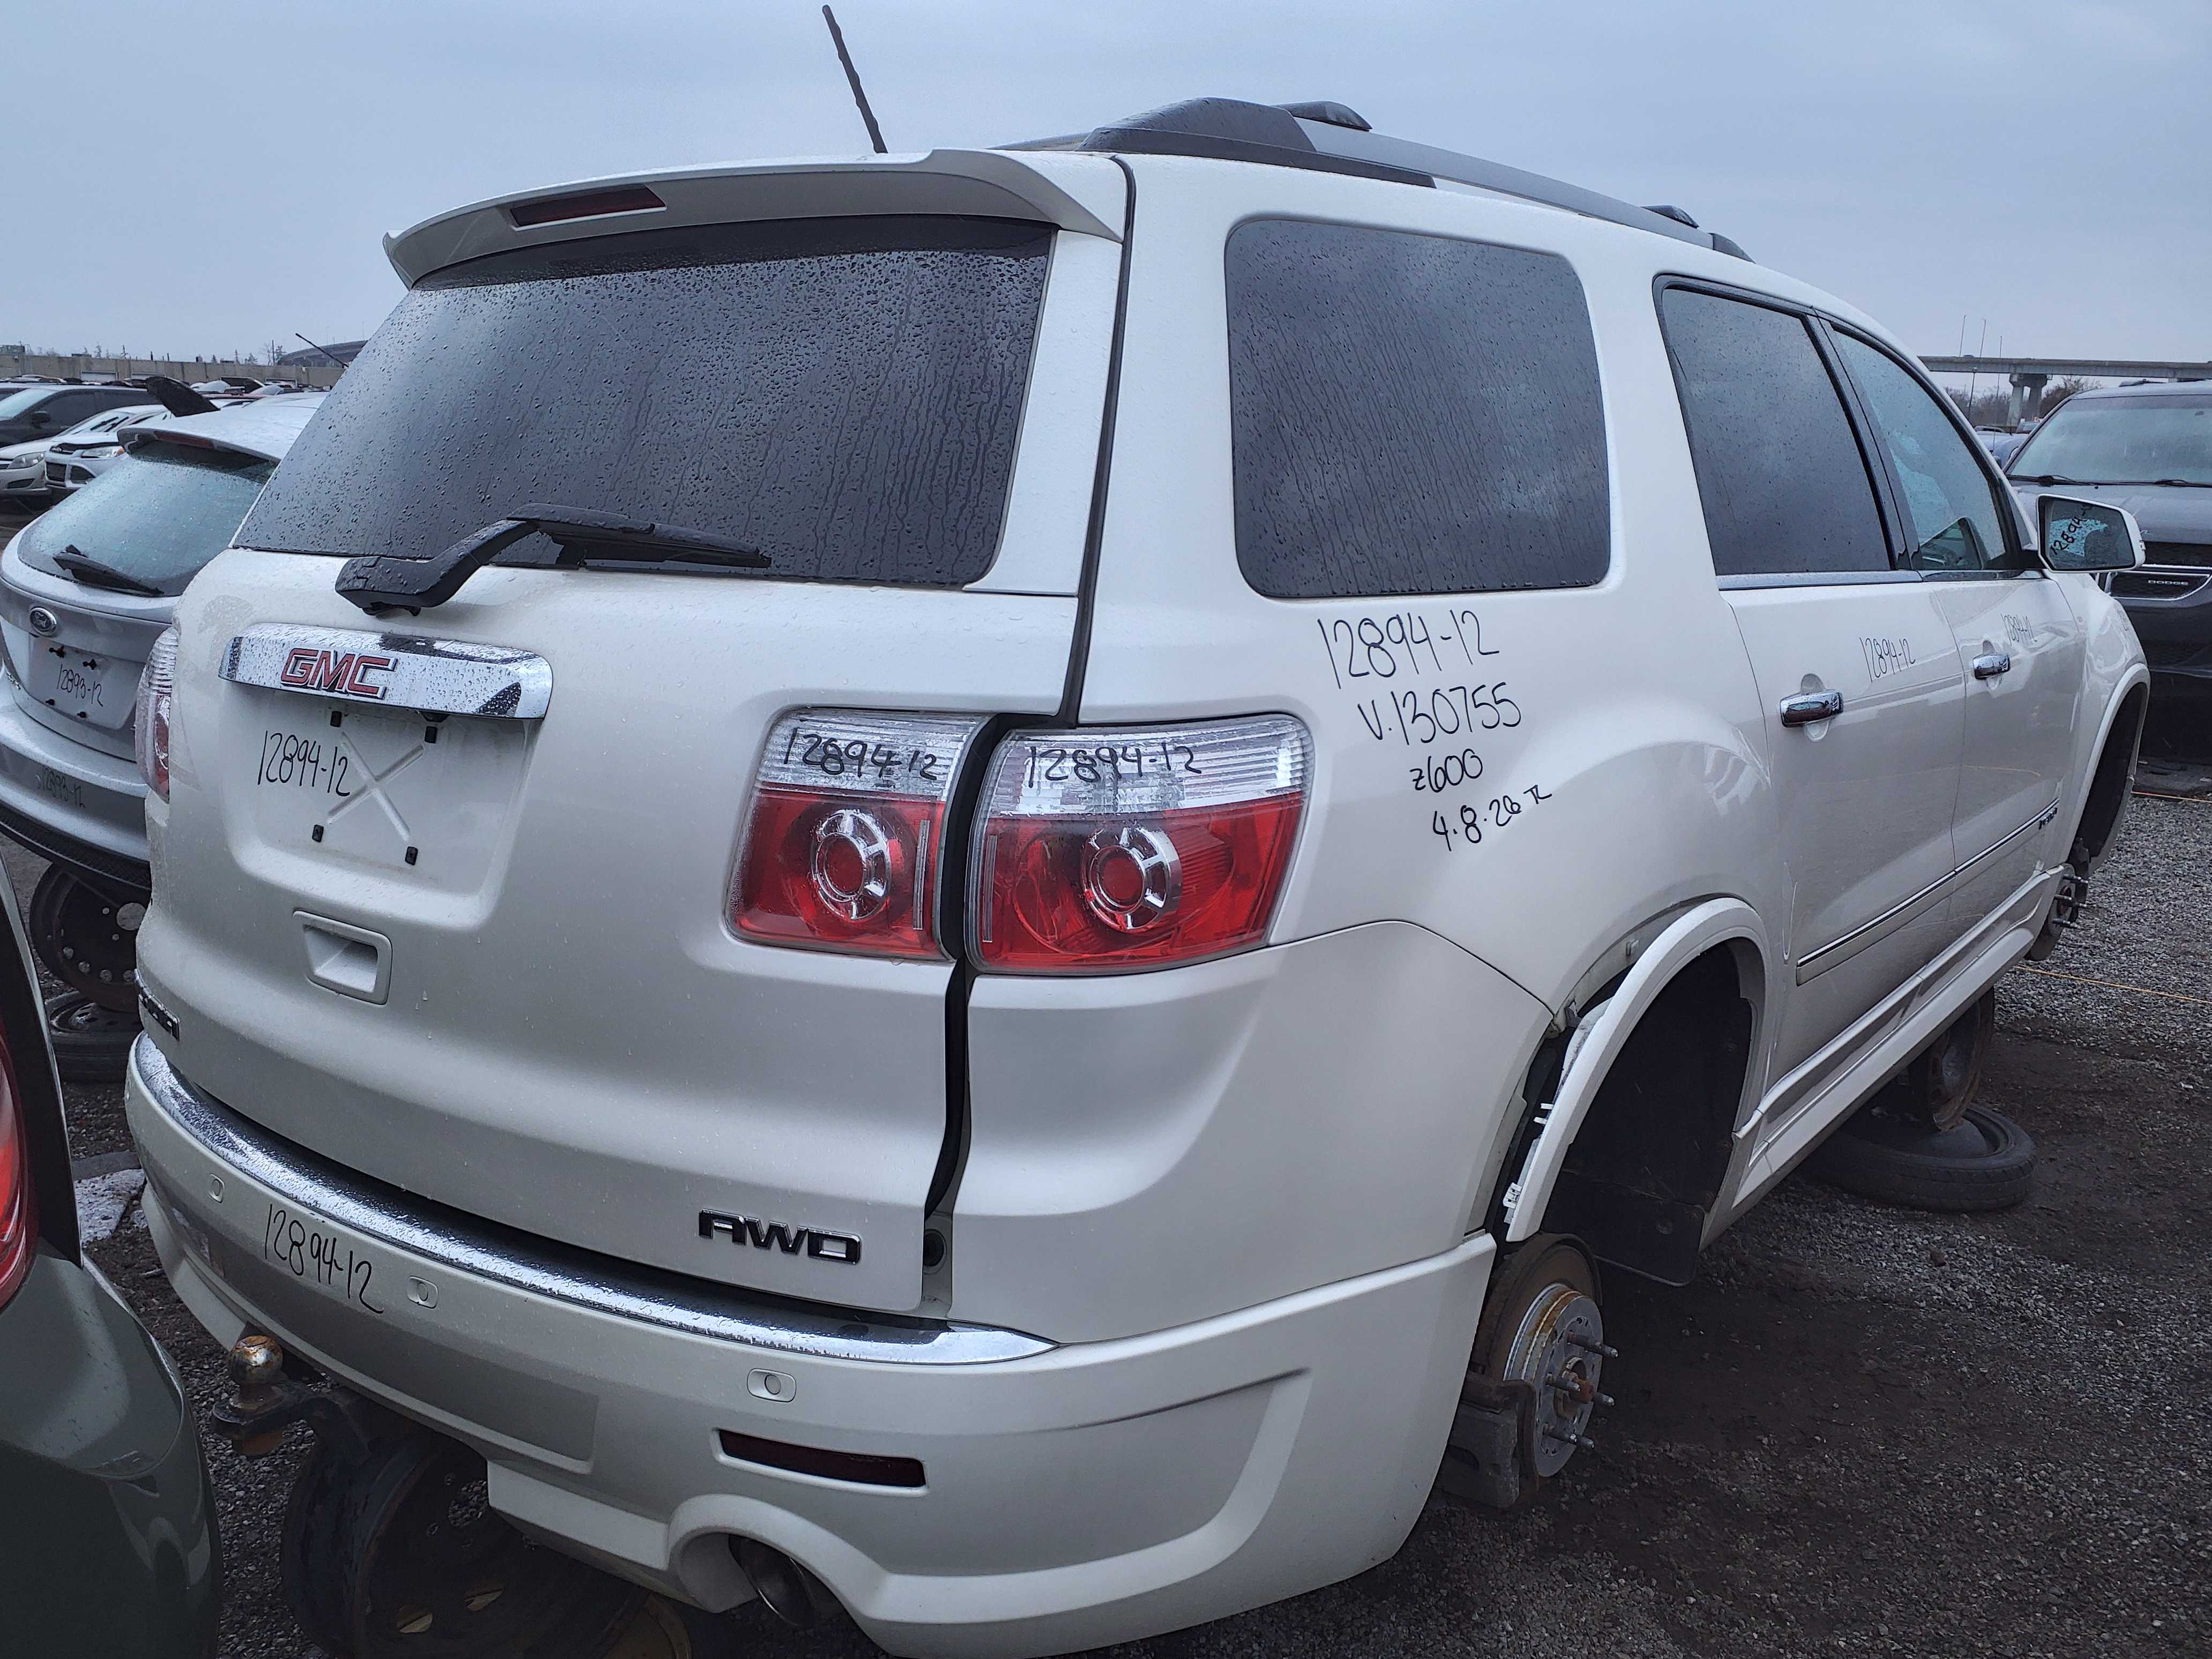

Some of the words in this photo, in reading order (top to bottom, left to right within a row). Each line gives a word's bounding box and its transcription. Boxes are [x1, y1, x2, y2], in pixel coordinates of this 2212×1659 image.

[280, 647, 398, 700] GMC
[1317, 609, 1500, 690] 12894-12
[1859, 637, 1916, 683] 12894-12
[56, 664, 103, 707] 12893-12
[257, 730, 350, 797] 12894-12
[1028, 742, 1202, 788] 12894-12
[265, 1203, 384, 1314] 12894-12
[698, 1208, 862, 1265] AWD
